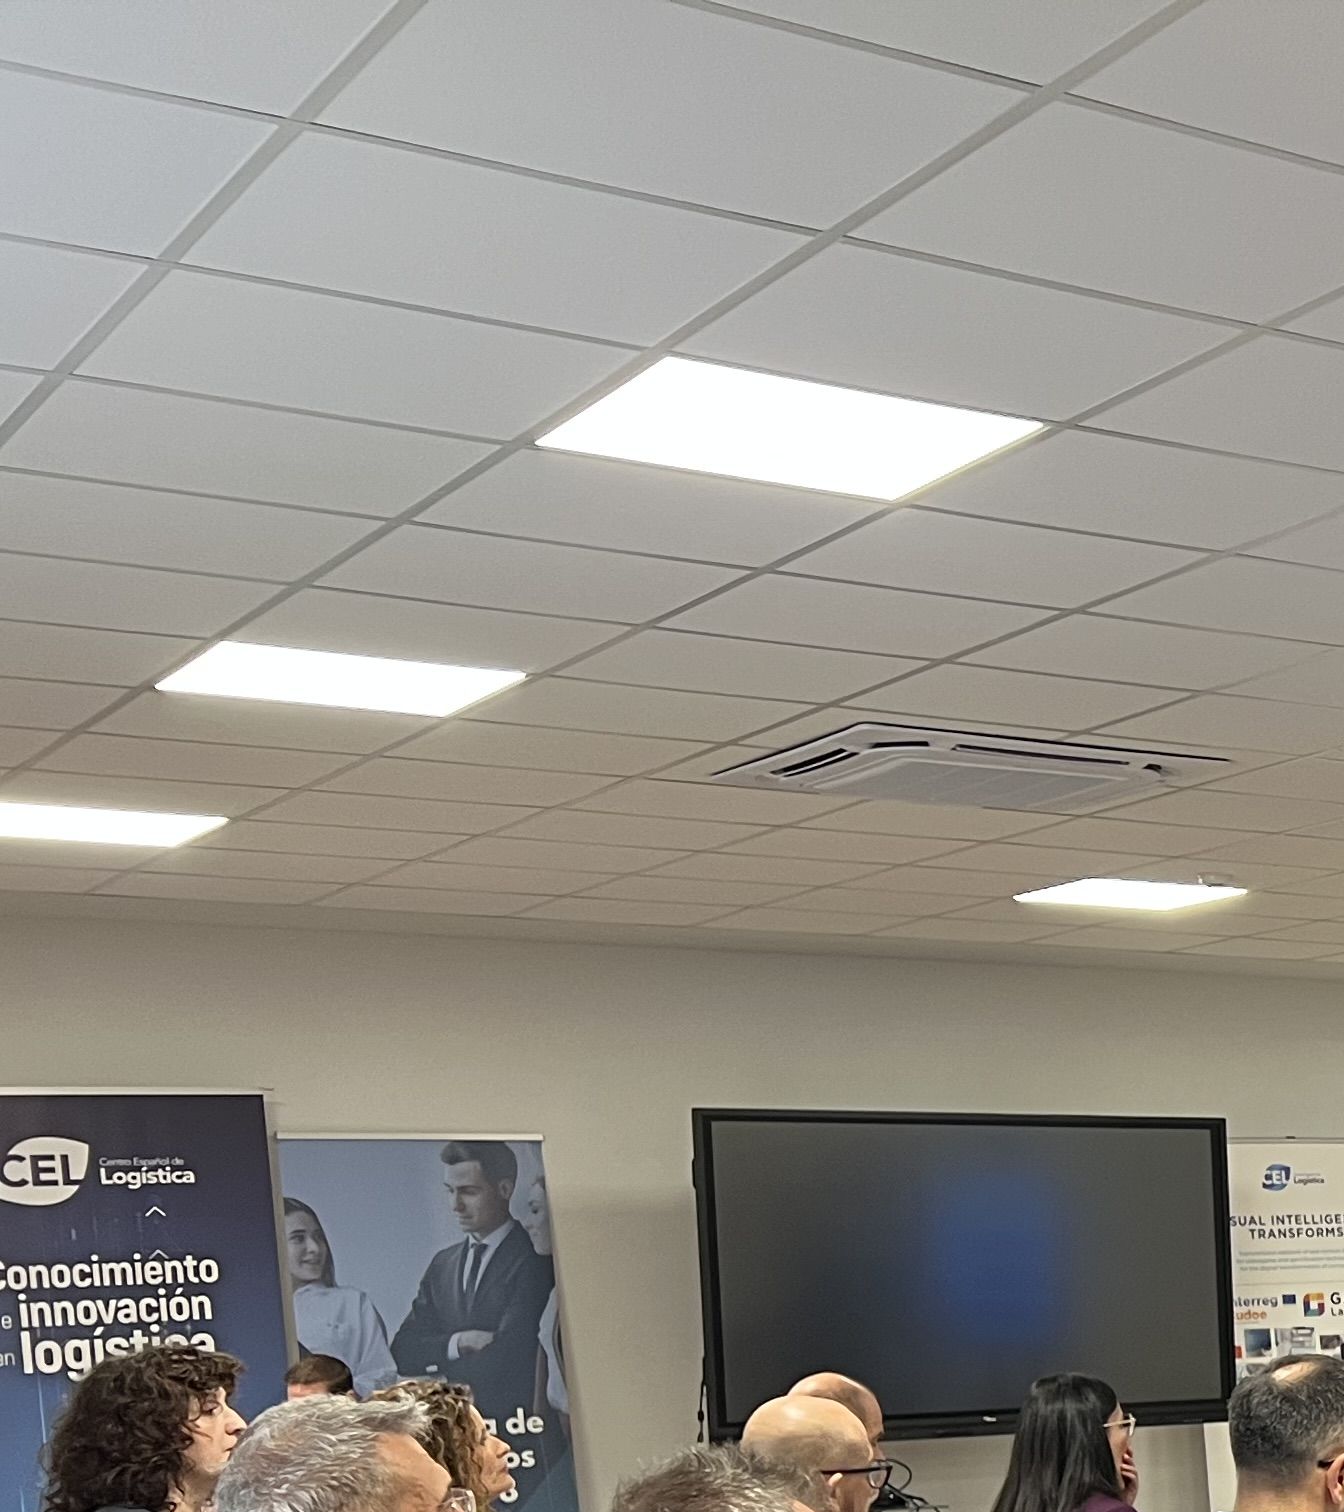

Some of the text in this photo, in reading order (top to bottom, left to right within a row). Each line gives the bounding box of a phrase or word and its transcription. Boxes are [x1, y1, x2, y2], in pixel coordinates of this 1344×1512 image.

[0, 1154, 85, 1188] CEL
[100, 1167, 196, 1190] Logística
[1262, 1170, 1290, 1185] CEL
[1230, 1215, 1265, 1227] SUAL
[1249, 1227, 1344, 1239] TRANSFORMS
[1, 1287, 213, 1330] e innovación
[1236, 1310, 1267, 1320] udoe
[506, 1407, 545, 1435] de
